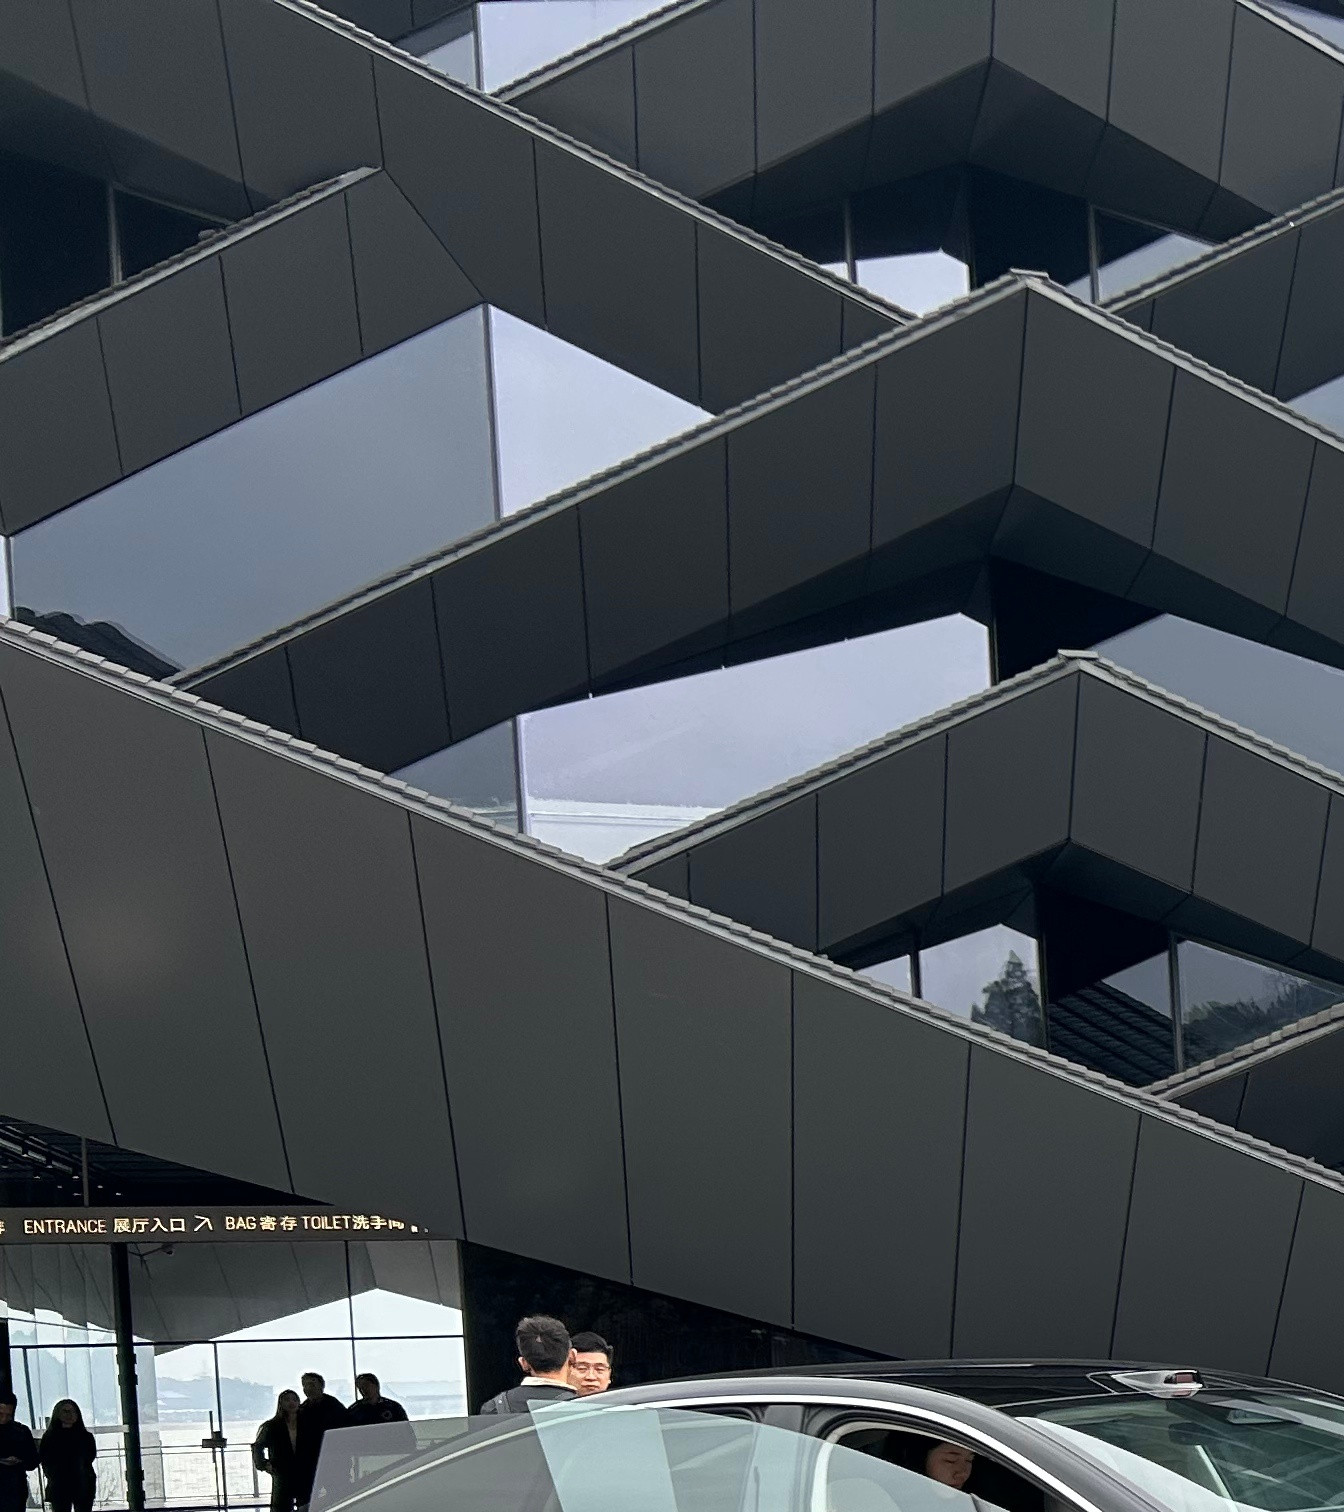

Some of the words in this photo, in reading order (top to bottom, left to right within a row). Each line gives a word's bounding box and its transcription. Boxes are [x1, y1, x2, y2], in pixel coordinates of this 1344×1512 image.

[24, 1219, 107, 1234] ENTRANCE
[113, 1217, 186, 1233] 展厅入口
[225, 1216, 256, 1230] BAG
[259, 1215, 298, 1231] 寄存
[301, 1215, 351, 1230] TOILET
